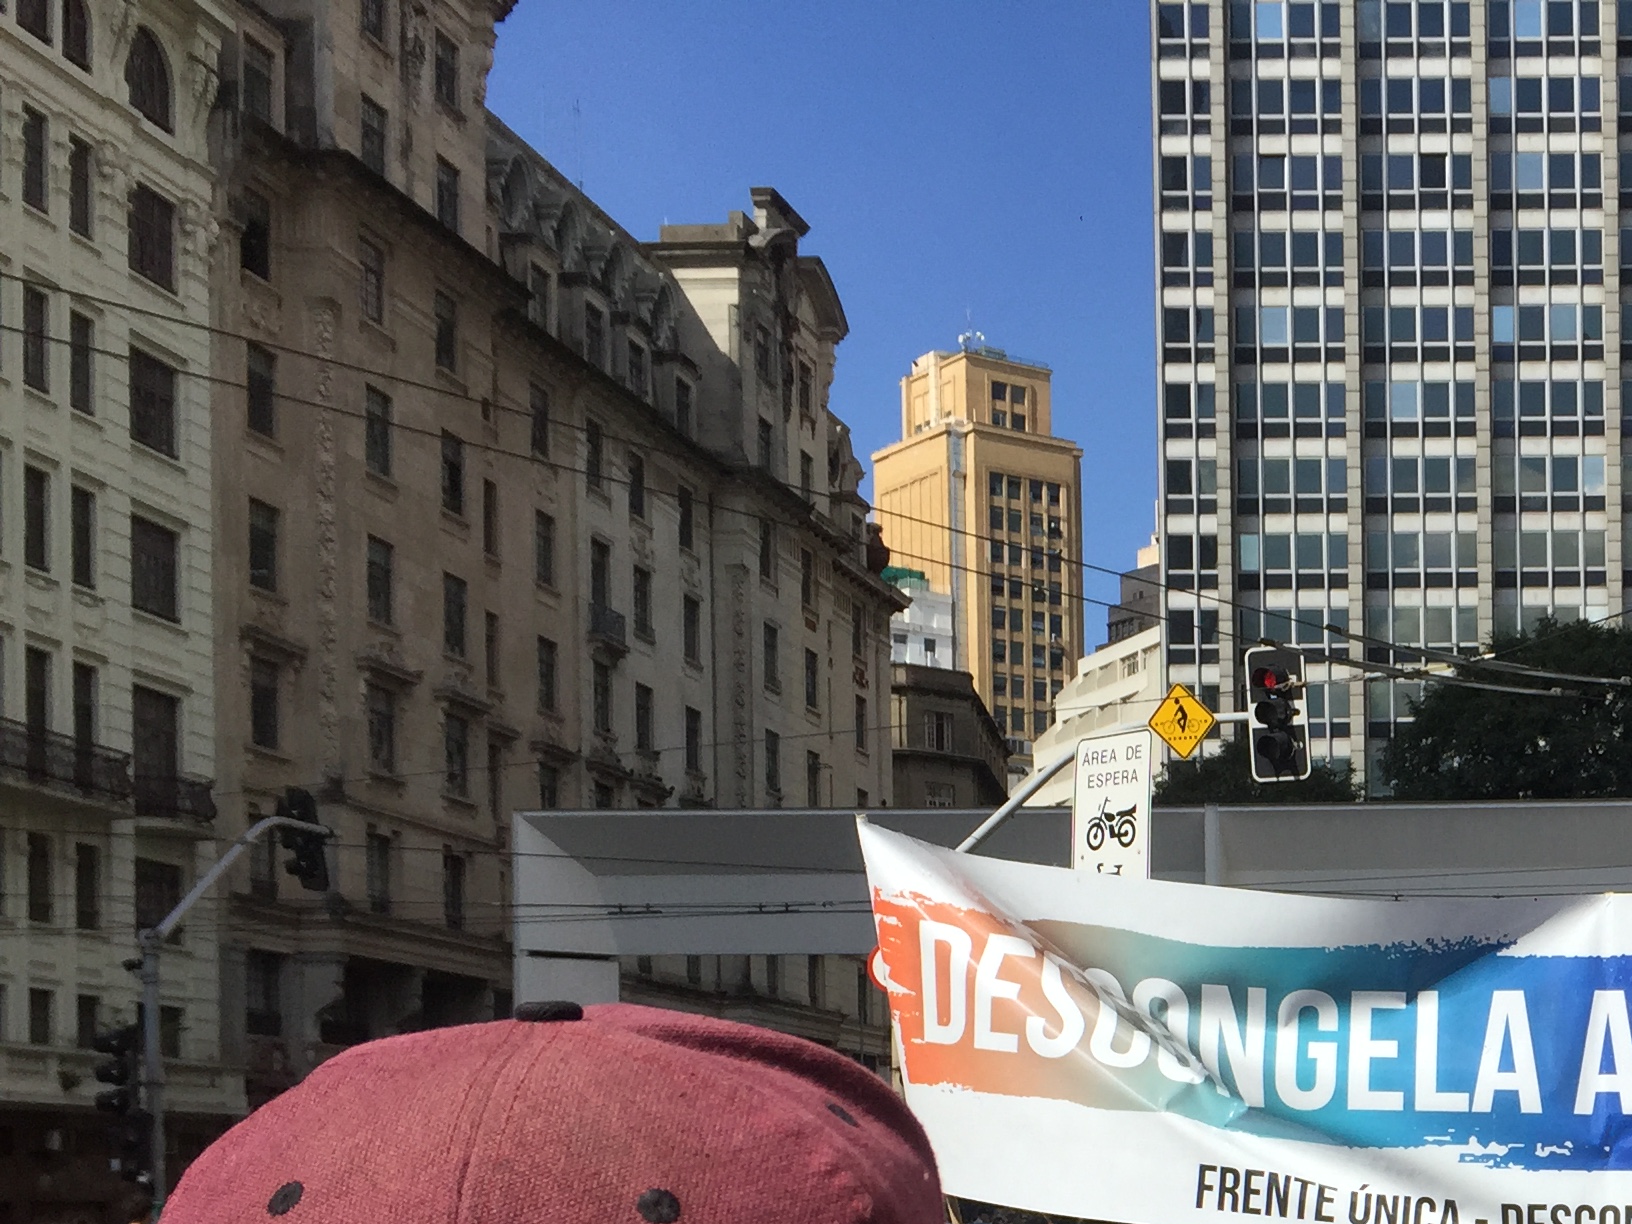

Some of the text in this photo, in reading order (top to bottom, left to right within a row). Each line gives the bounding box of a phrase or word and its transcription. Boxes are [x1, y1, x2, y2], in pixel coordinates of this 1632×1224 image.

[1082, 744, 1143, 767] ÁREA DE
[1087, 769, 1139, 789] ESPERA
[918, 918, 1543, 1114] DESCONGELA
[1196, 1163, 1339, 1224] FRENTE
